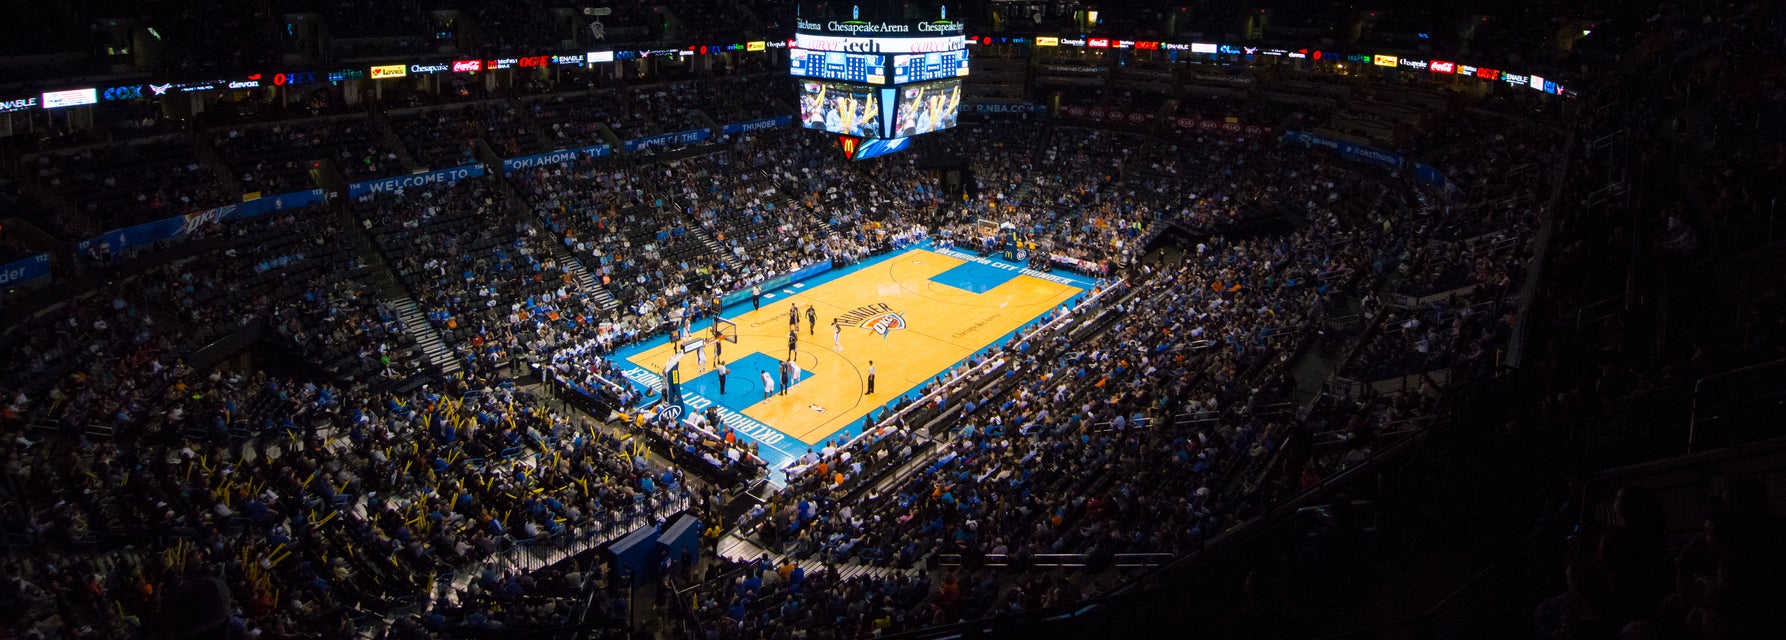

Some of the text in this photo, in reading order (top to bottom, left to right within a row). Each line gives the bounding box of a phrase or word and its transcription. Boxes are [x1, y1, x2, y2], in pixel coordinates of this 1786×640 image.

[828, 21, 909, 35] Chesapeake Arena
[917, 21, 957, 35] Chesapeake
[411, 63, 448, 73] Chesapeake
[229, 81, 259, 89] devon
[1506, 73, 1528, 83] ENABLE
[103, 84, 142, 100] COX
[742, 120, 776, 131] THUNDER
[682, 132, 698, 141] THE
[513, 152, 576, 169] OKLAHOMA
[582, 148, 602, 158] TY
[369, 172, 445, 192] WELCOME
[450, 169, 468, 180] TO
[36, 254, 48, 263] 112
[934, 248, 1073, 284] OKLAHOMA CITY THUNDER
[0, 267, 25, 284] der
[837, 302, 893, 327] THUNDER
[872, 315, 894, 336] OKC
[662, 407, 678, 420] KIA
[716, 405, 785, 444] OKLAHOM
